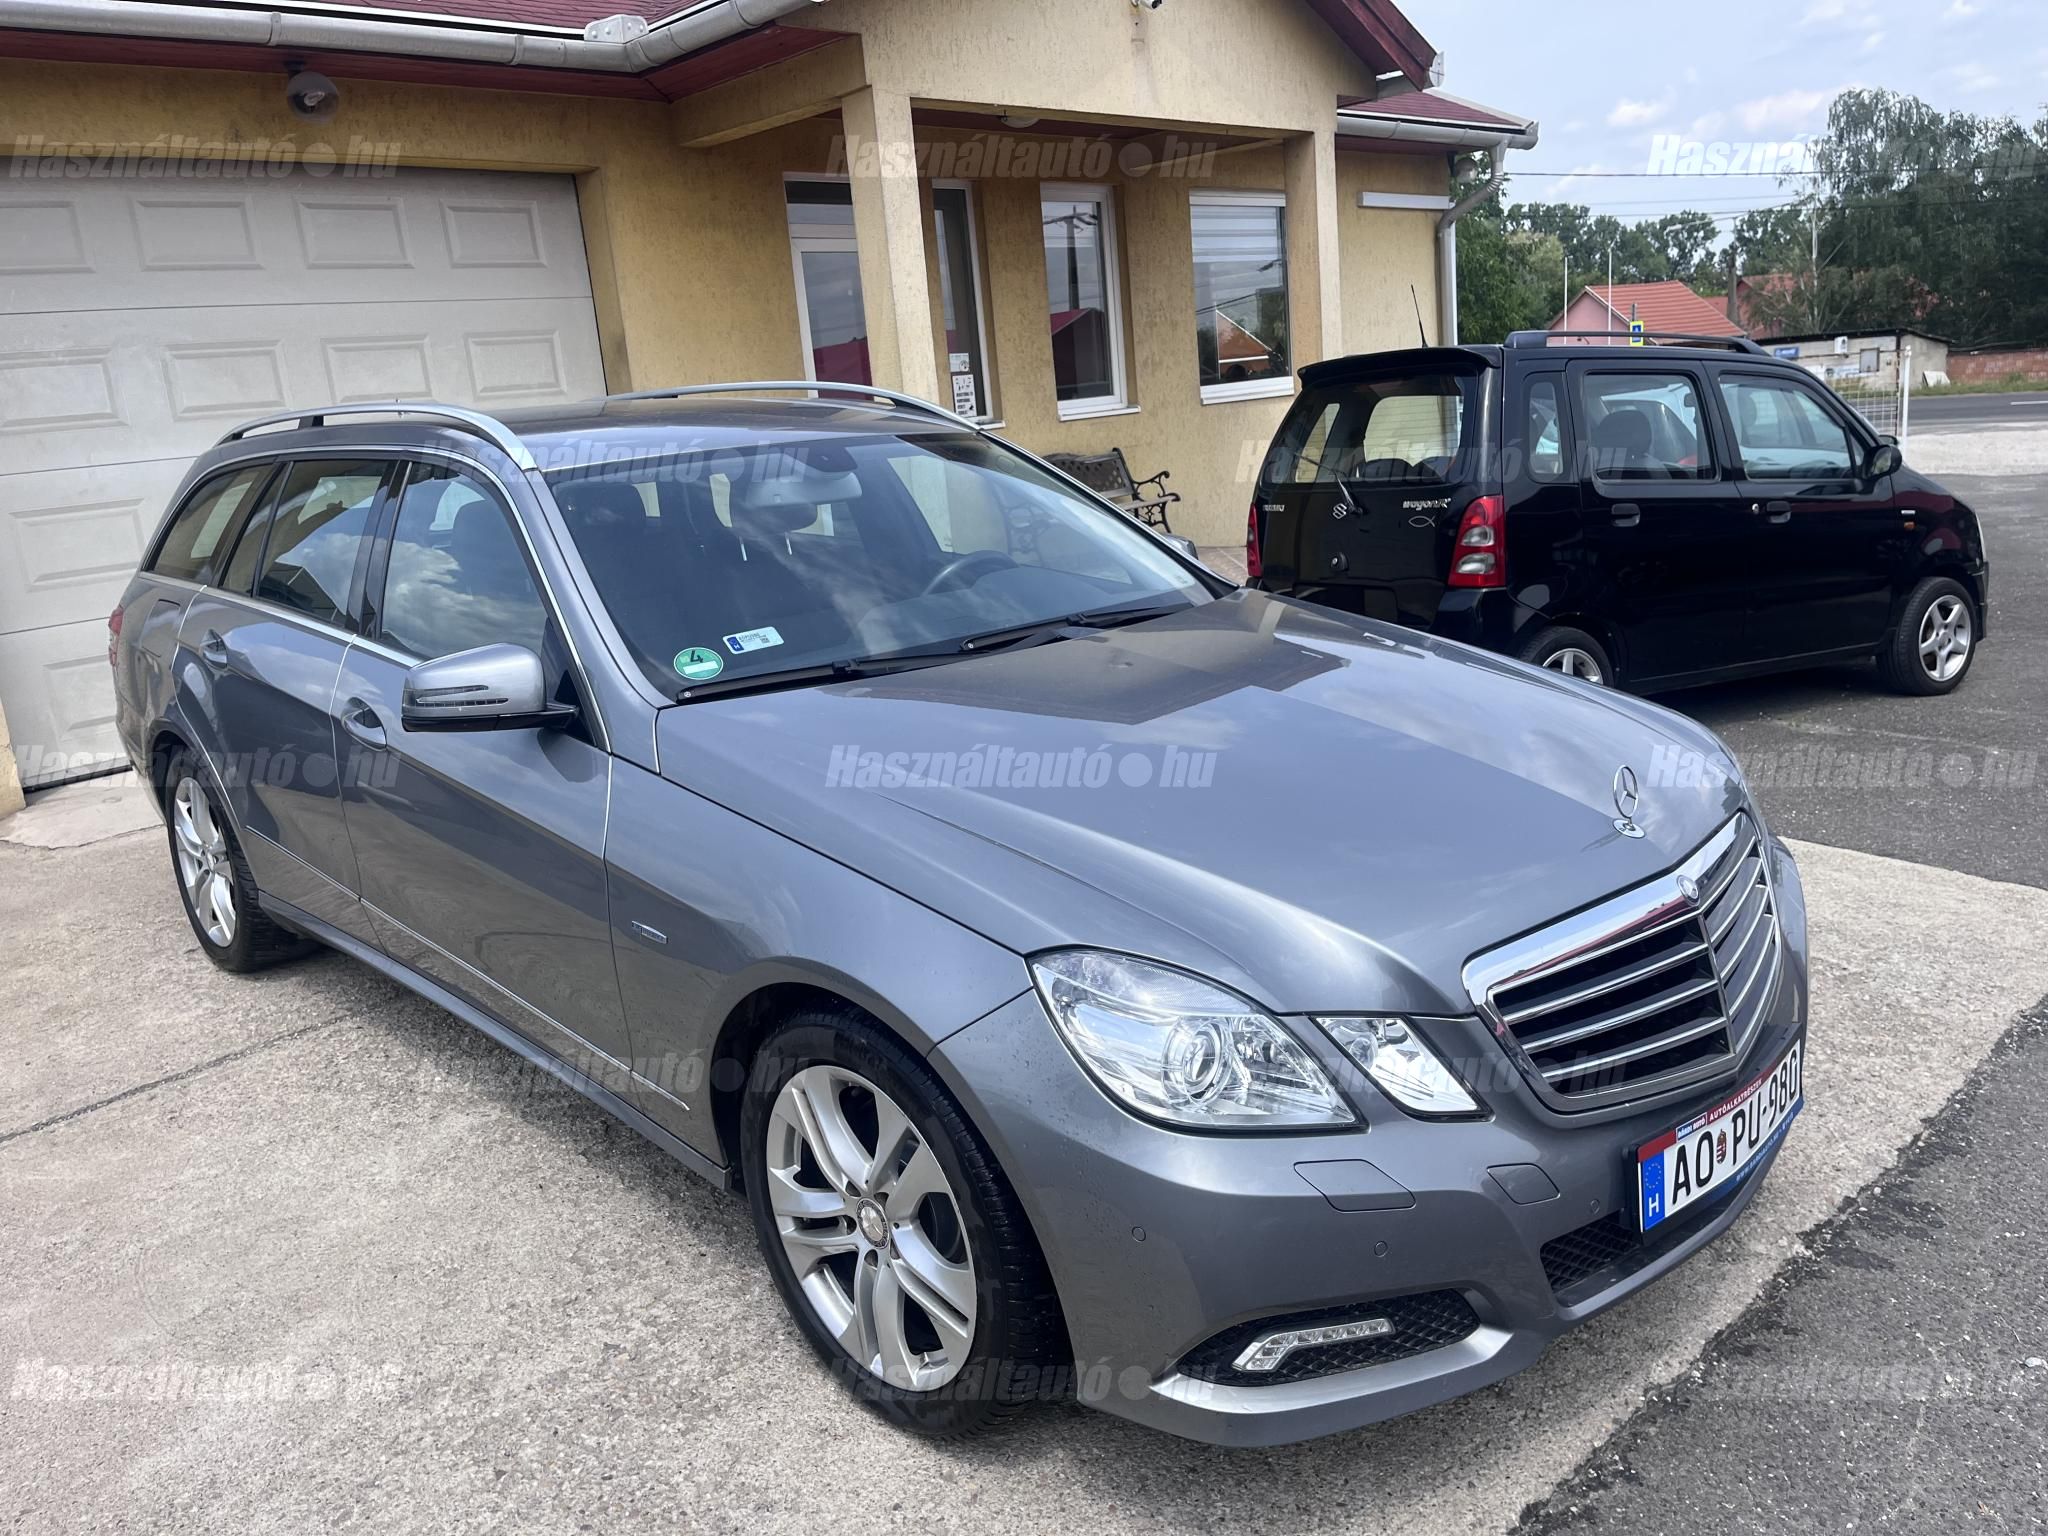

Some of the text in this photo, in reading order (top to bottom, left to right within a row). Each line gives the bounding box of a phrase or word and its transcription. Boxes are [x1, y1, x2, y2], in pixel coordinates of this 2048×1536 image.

[690, 650, 704, 663] 4
[1672, 1130, 1714, 1205] AO
[1648, 1193, 1660, 1217] H
